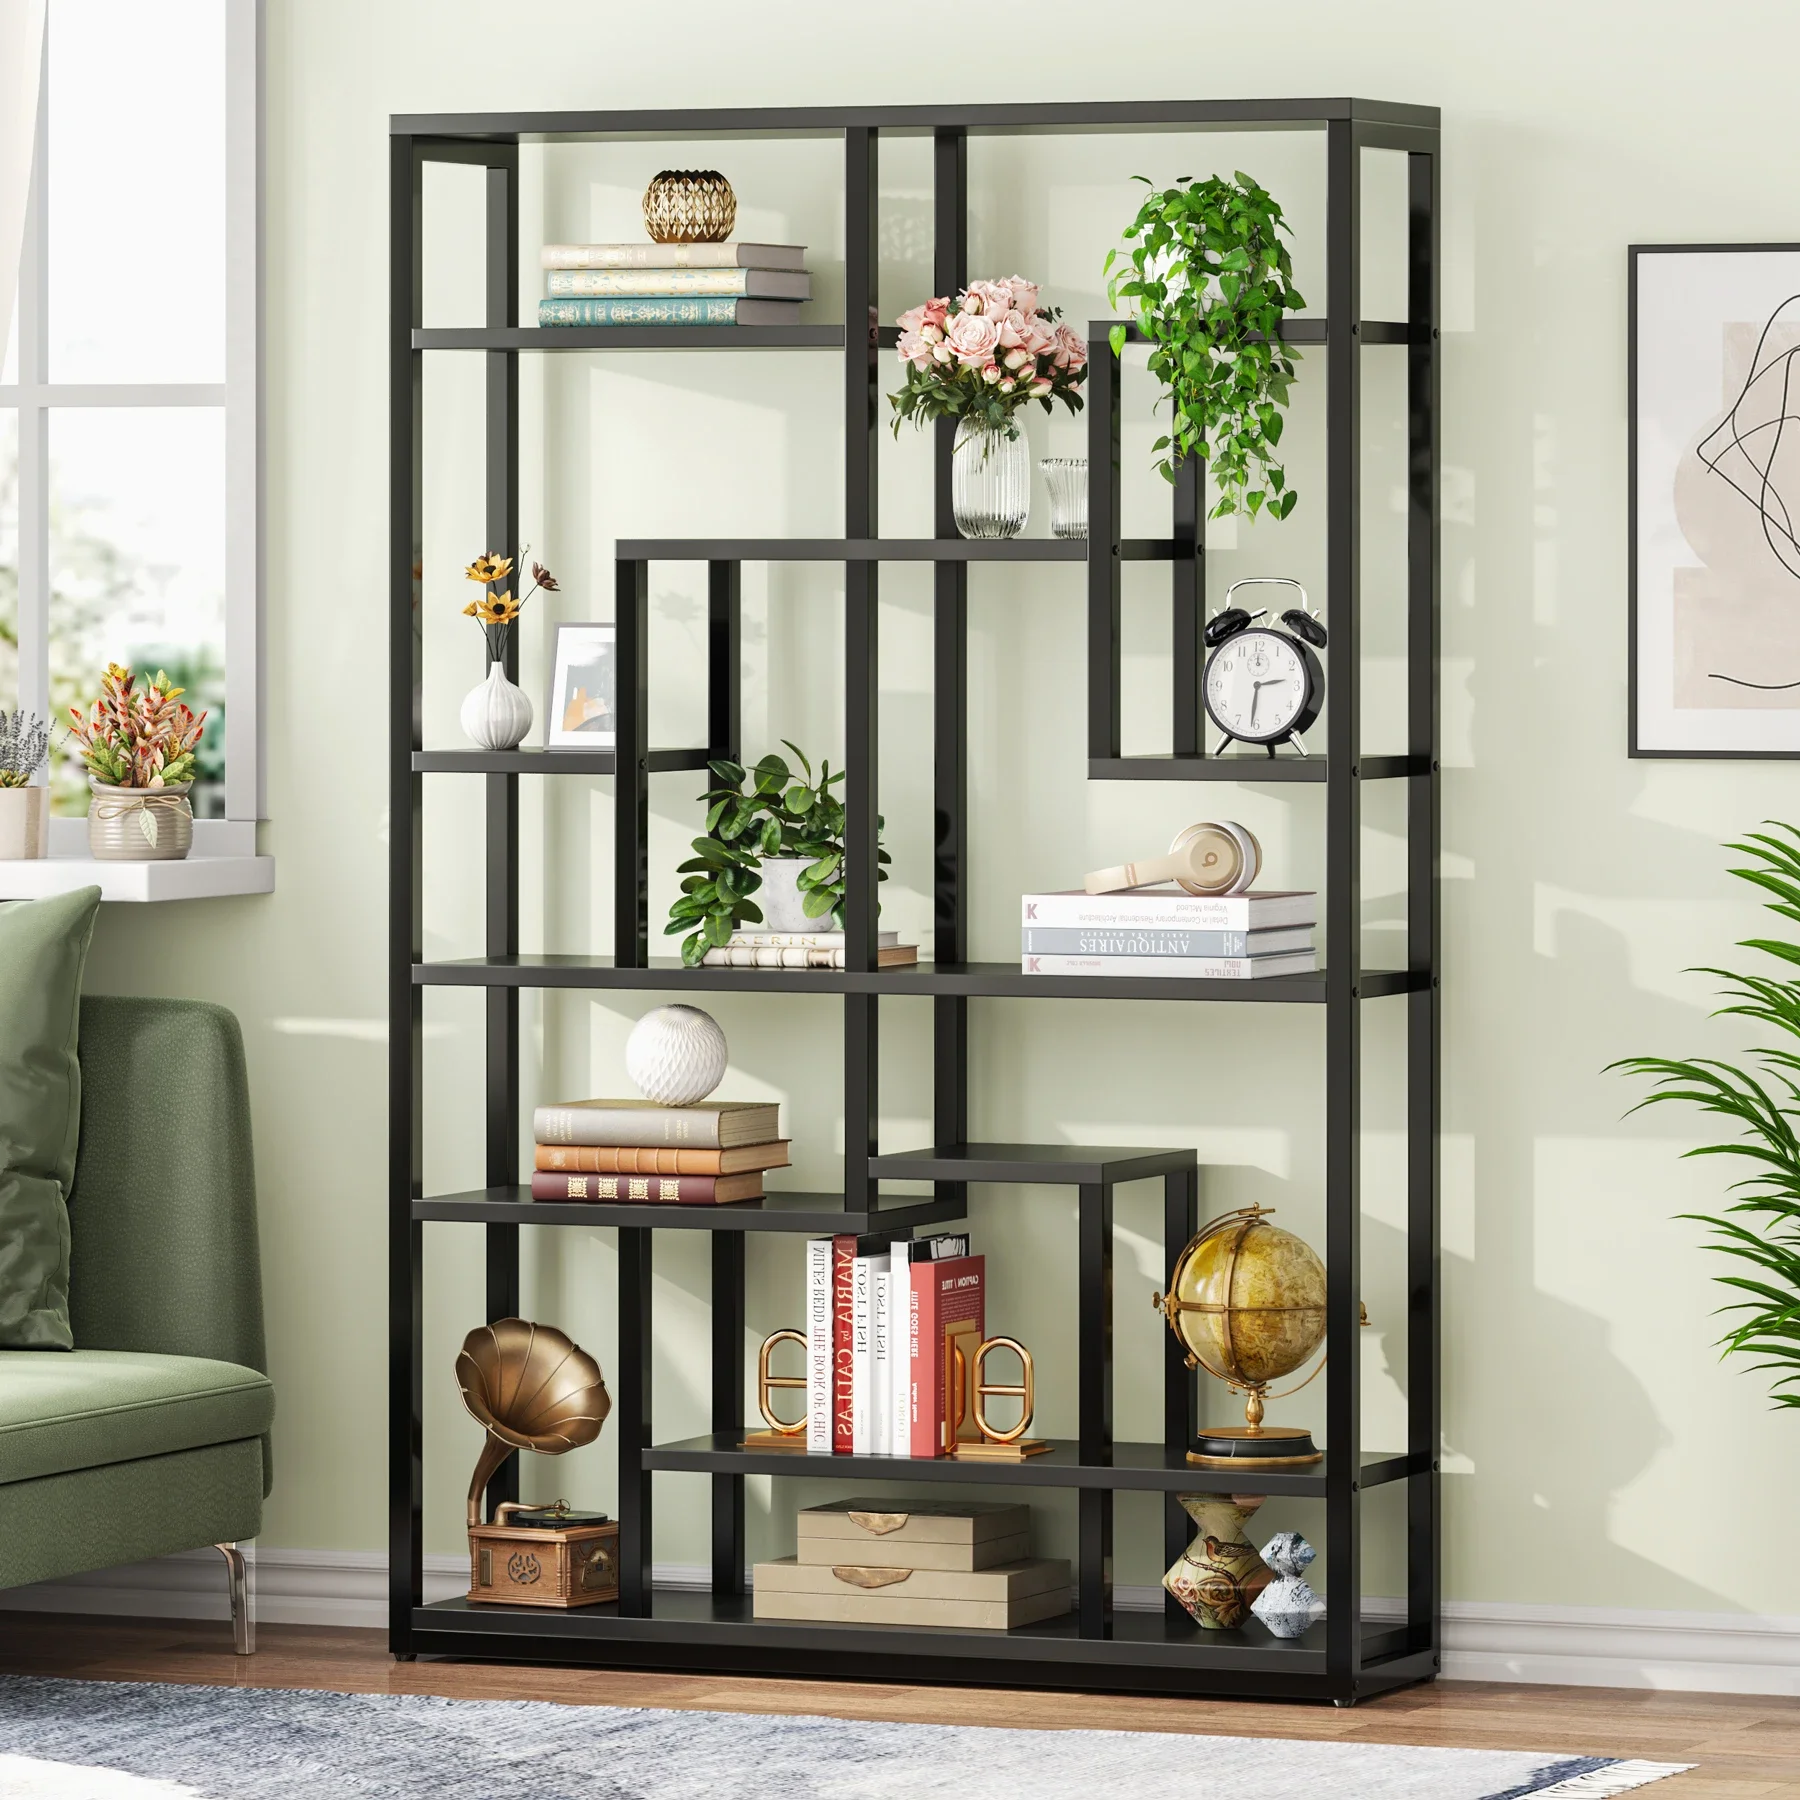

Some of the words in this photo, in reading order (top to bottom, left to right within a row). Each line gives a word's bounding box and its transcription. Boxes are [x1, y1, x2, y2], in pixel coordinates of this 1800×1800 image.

[1238, 646, 1246, 657] 11
[1254, 641, 1265, 653] 12
[1275, 646, 1280, 657] 1
[1223, 661, 1233, 672] 10
[1288, 660, 1296, 671] 2
[1215, 681, 1223, 692] 9
[1293, 680, 1300, 691] 3
[1220, 700, 1228, 711] 8
[1286, 700, 1294, 711] 4
[1234, 714, 1242, 725] 7
[1253, 719, 1260, 731] 6
[1274, 714, 1282, 725] 5
[1176, 904, 1203, 912] McLeod
[1204, 904, 1228, 912] Virginia
[1078, 914, 1117, 923] Architecture
[1118, 914, 1153, 923] Residential
[1155, 915, 1201, 924] Contemporary
[1202, 916, 1208, 924] in
[1210, 916, 1228, 924] Detail
[732, 935, 817, 946] AERIN
[1079, 937, 1191, 954] ANTIQUAIRES
[1224, 960, 1241, 968] NOW
[1205, 968, 1241, 977] TEXTILES
